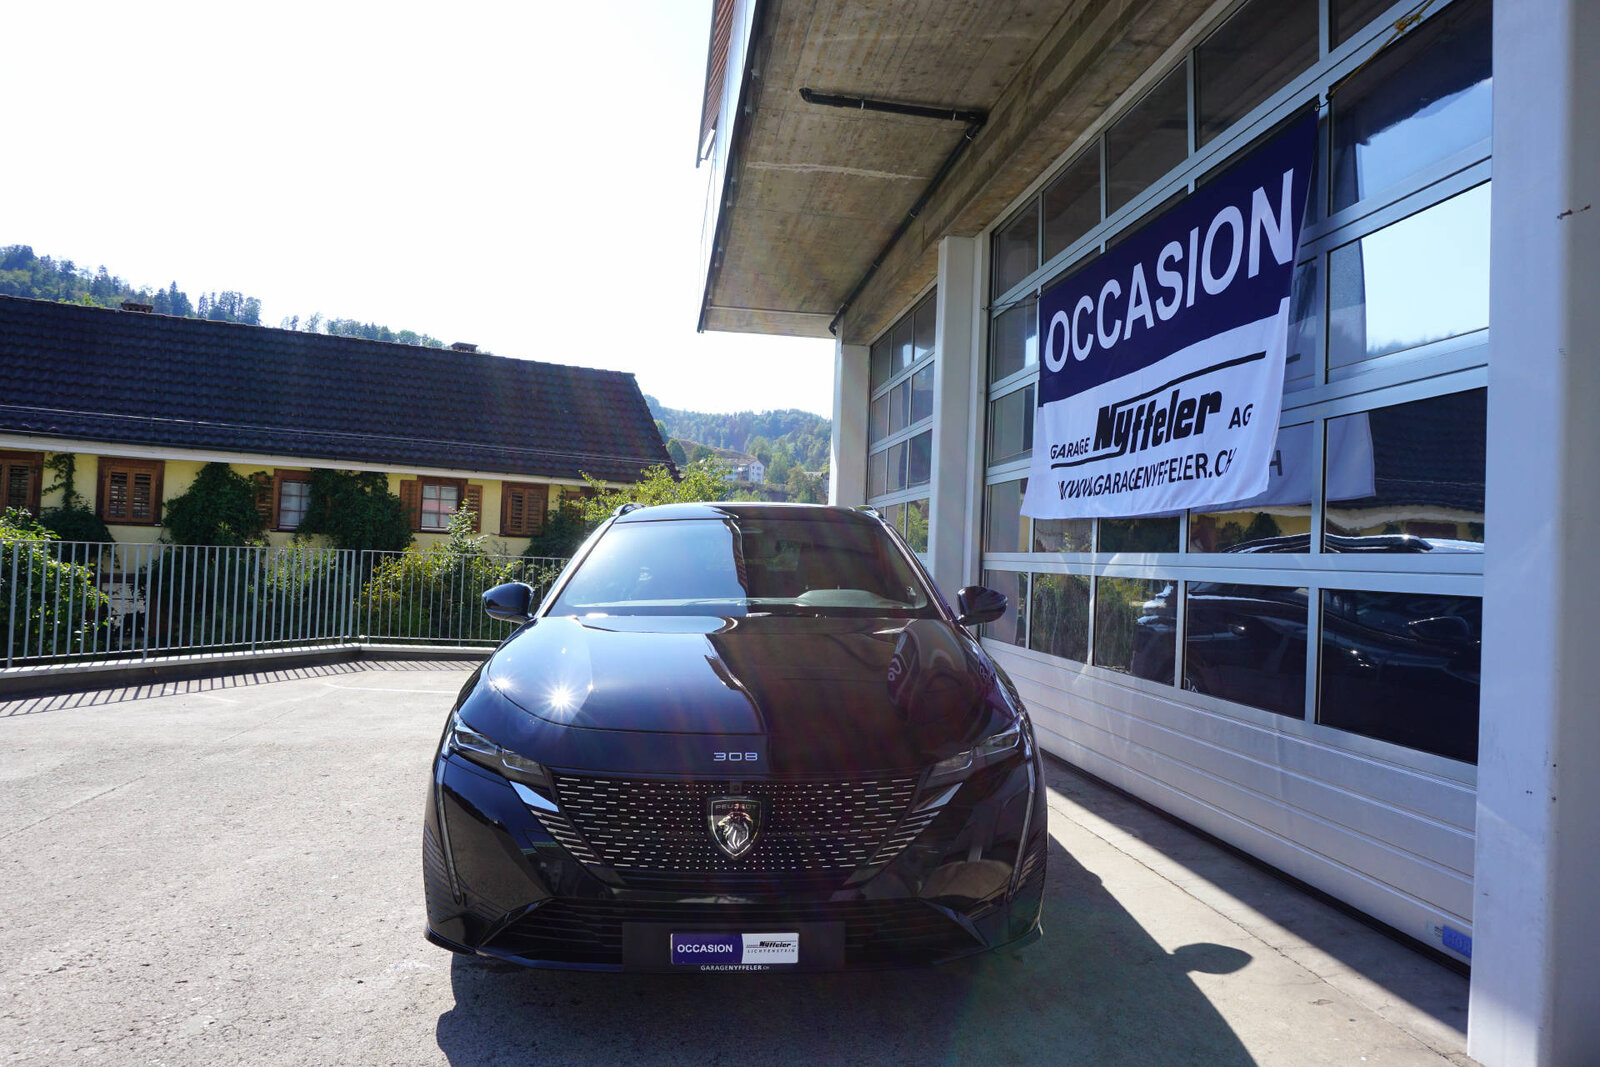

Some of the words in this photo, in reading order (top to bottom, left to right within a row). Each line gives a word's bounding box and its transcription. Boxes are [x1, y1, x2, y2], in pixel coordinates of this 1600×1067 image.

[1045, 168, 1294, 373] OCCASION
[1050, 437, 1090, 460] GARAGE
[1093, 389, 1222, 453] Nyffeler
[1229, 404, 1253, 429] AG
[713, 752, 758, 761] 308
[677, 944, 733, 953] OCCASION
